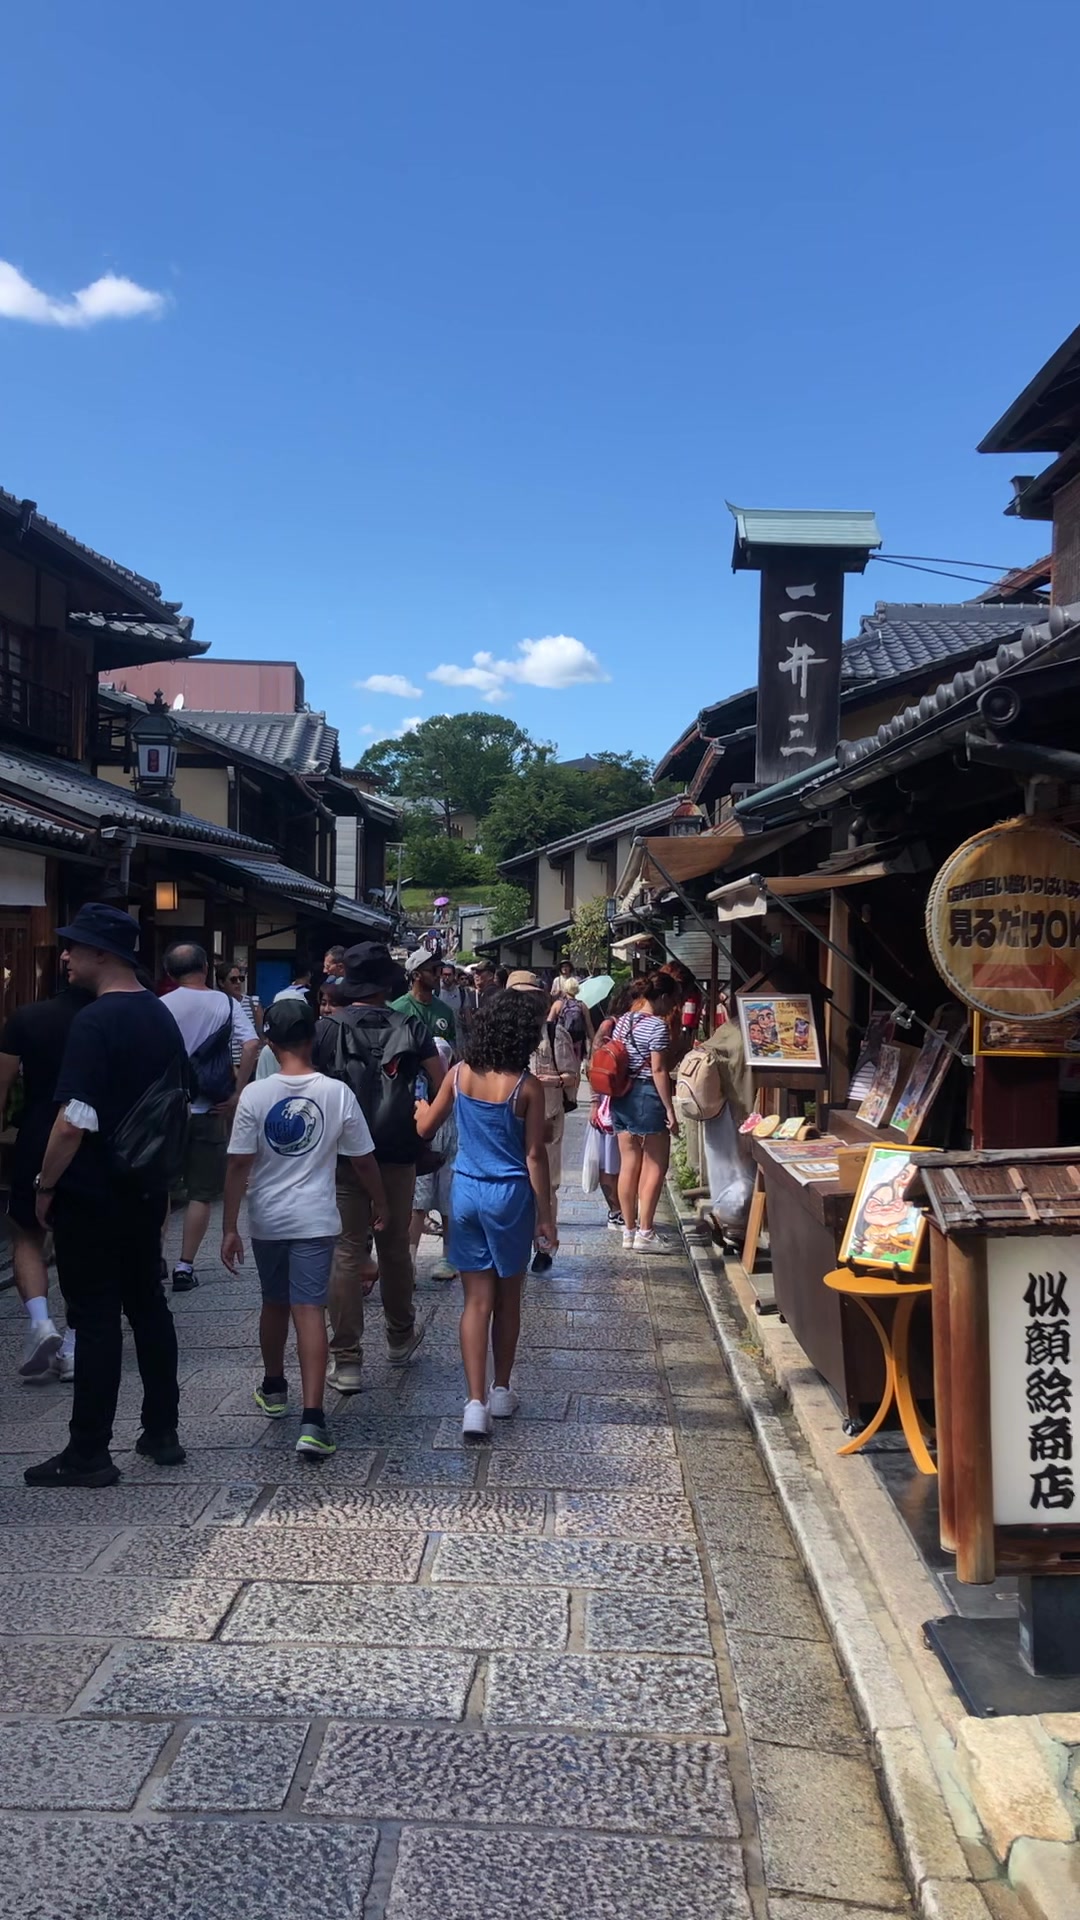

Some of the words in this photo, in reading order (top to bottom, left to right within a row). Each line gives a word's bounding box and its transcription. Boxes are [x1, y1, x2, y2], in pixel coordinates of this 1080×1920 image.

[778, 583, 832, 757] 二井三
[1023, 1271, 1075, 1509] 似顔絵商店
